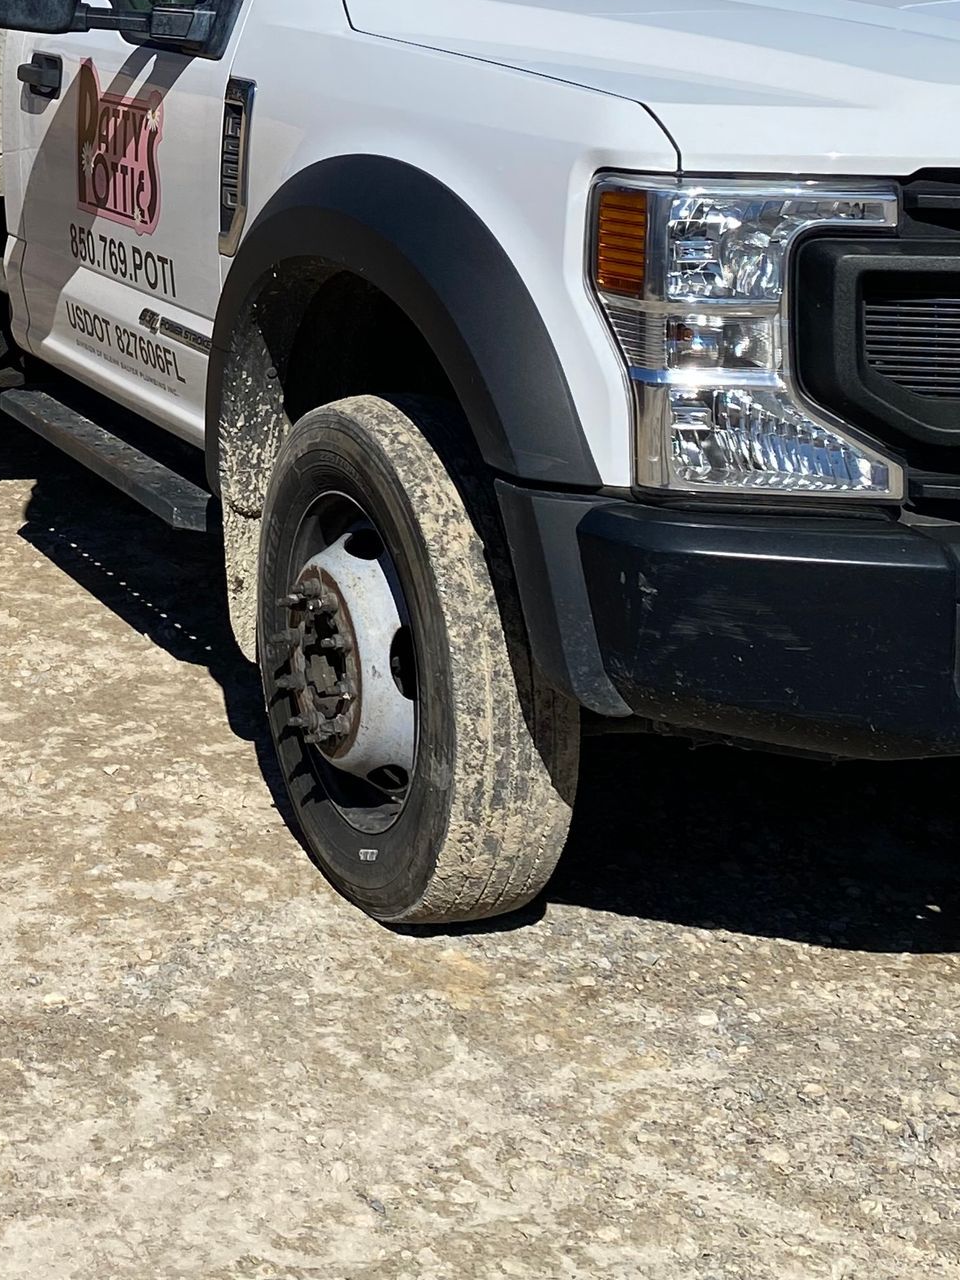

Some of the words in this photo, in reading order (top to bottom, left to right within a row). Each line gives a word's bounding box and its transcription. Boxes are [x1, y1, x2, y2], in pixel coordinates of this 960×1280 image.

[79, 63, 158, 164] PATTY'S
[70, 223, 176, 298] 850.769.POTI
[66, 300, 112, 347] USDOT
[115, 324, 187, 384] 827606FL
